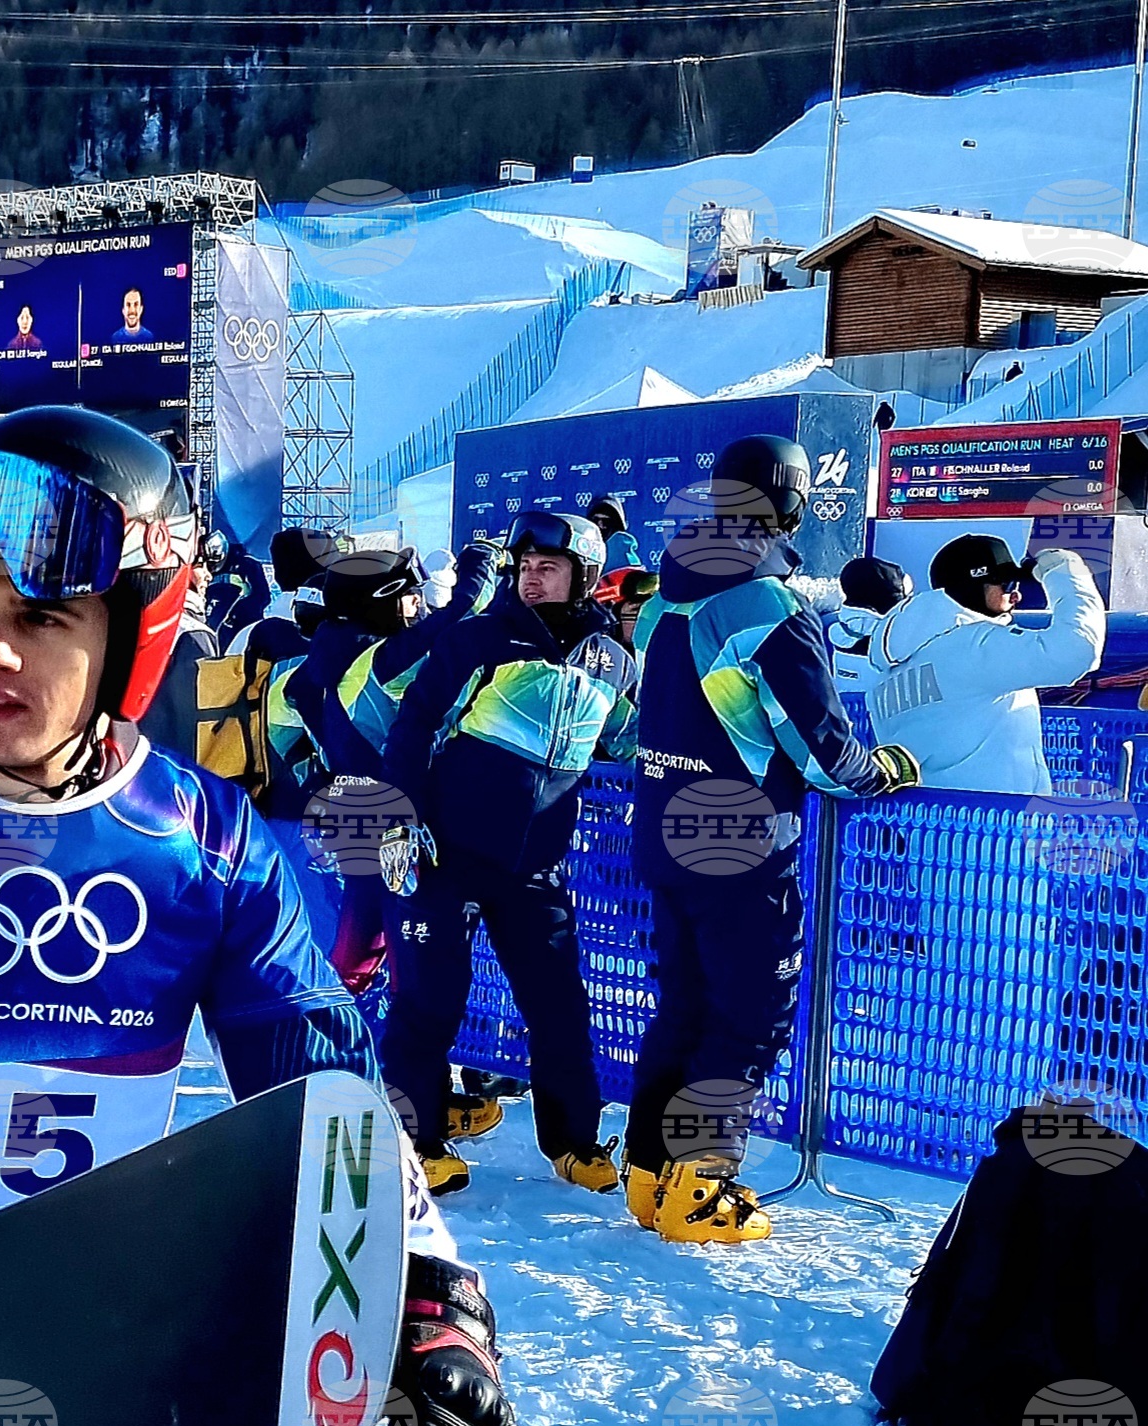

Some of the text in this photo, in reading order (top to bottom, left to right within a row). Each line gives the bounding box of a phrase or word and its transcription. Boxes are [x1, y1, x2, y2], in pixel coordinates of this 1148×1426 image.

[5, 235, 150, 259] MEN'S PGS QUALIFICATION RUN
[890, 436, 1107, 457] MEN'S PGS QUALIFICATION RUN HEAT 6/16
[891, 467, 903, 478] 27
[970, 566, 989, 577] EA7
[644, 762, 664, 779] 2026
[655, 752, 713, 773] CORTINA
[109, 1009, 155, 1027] 2026
